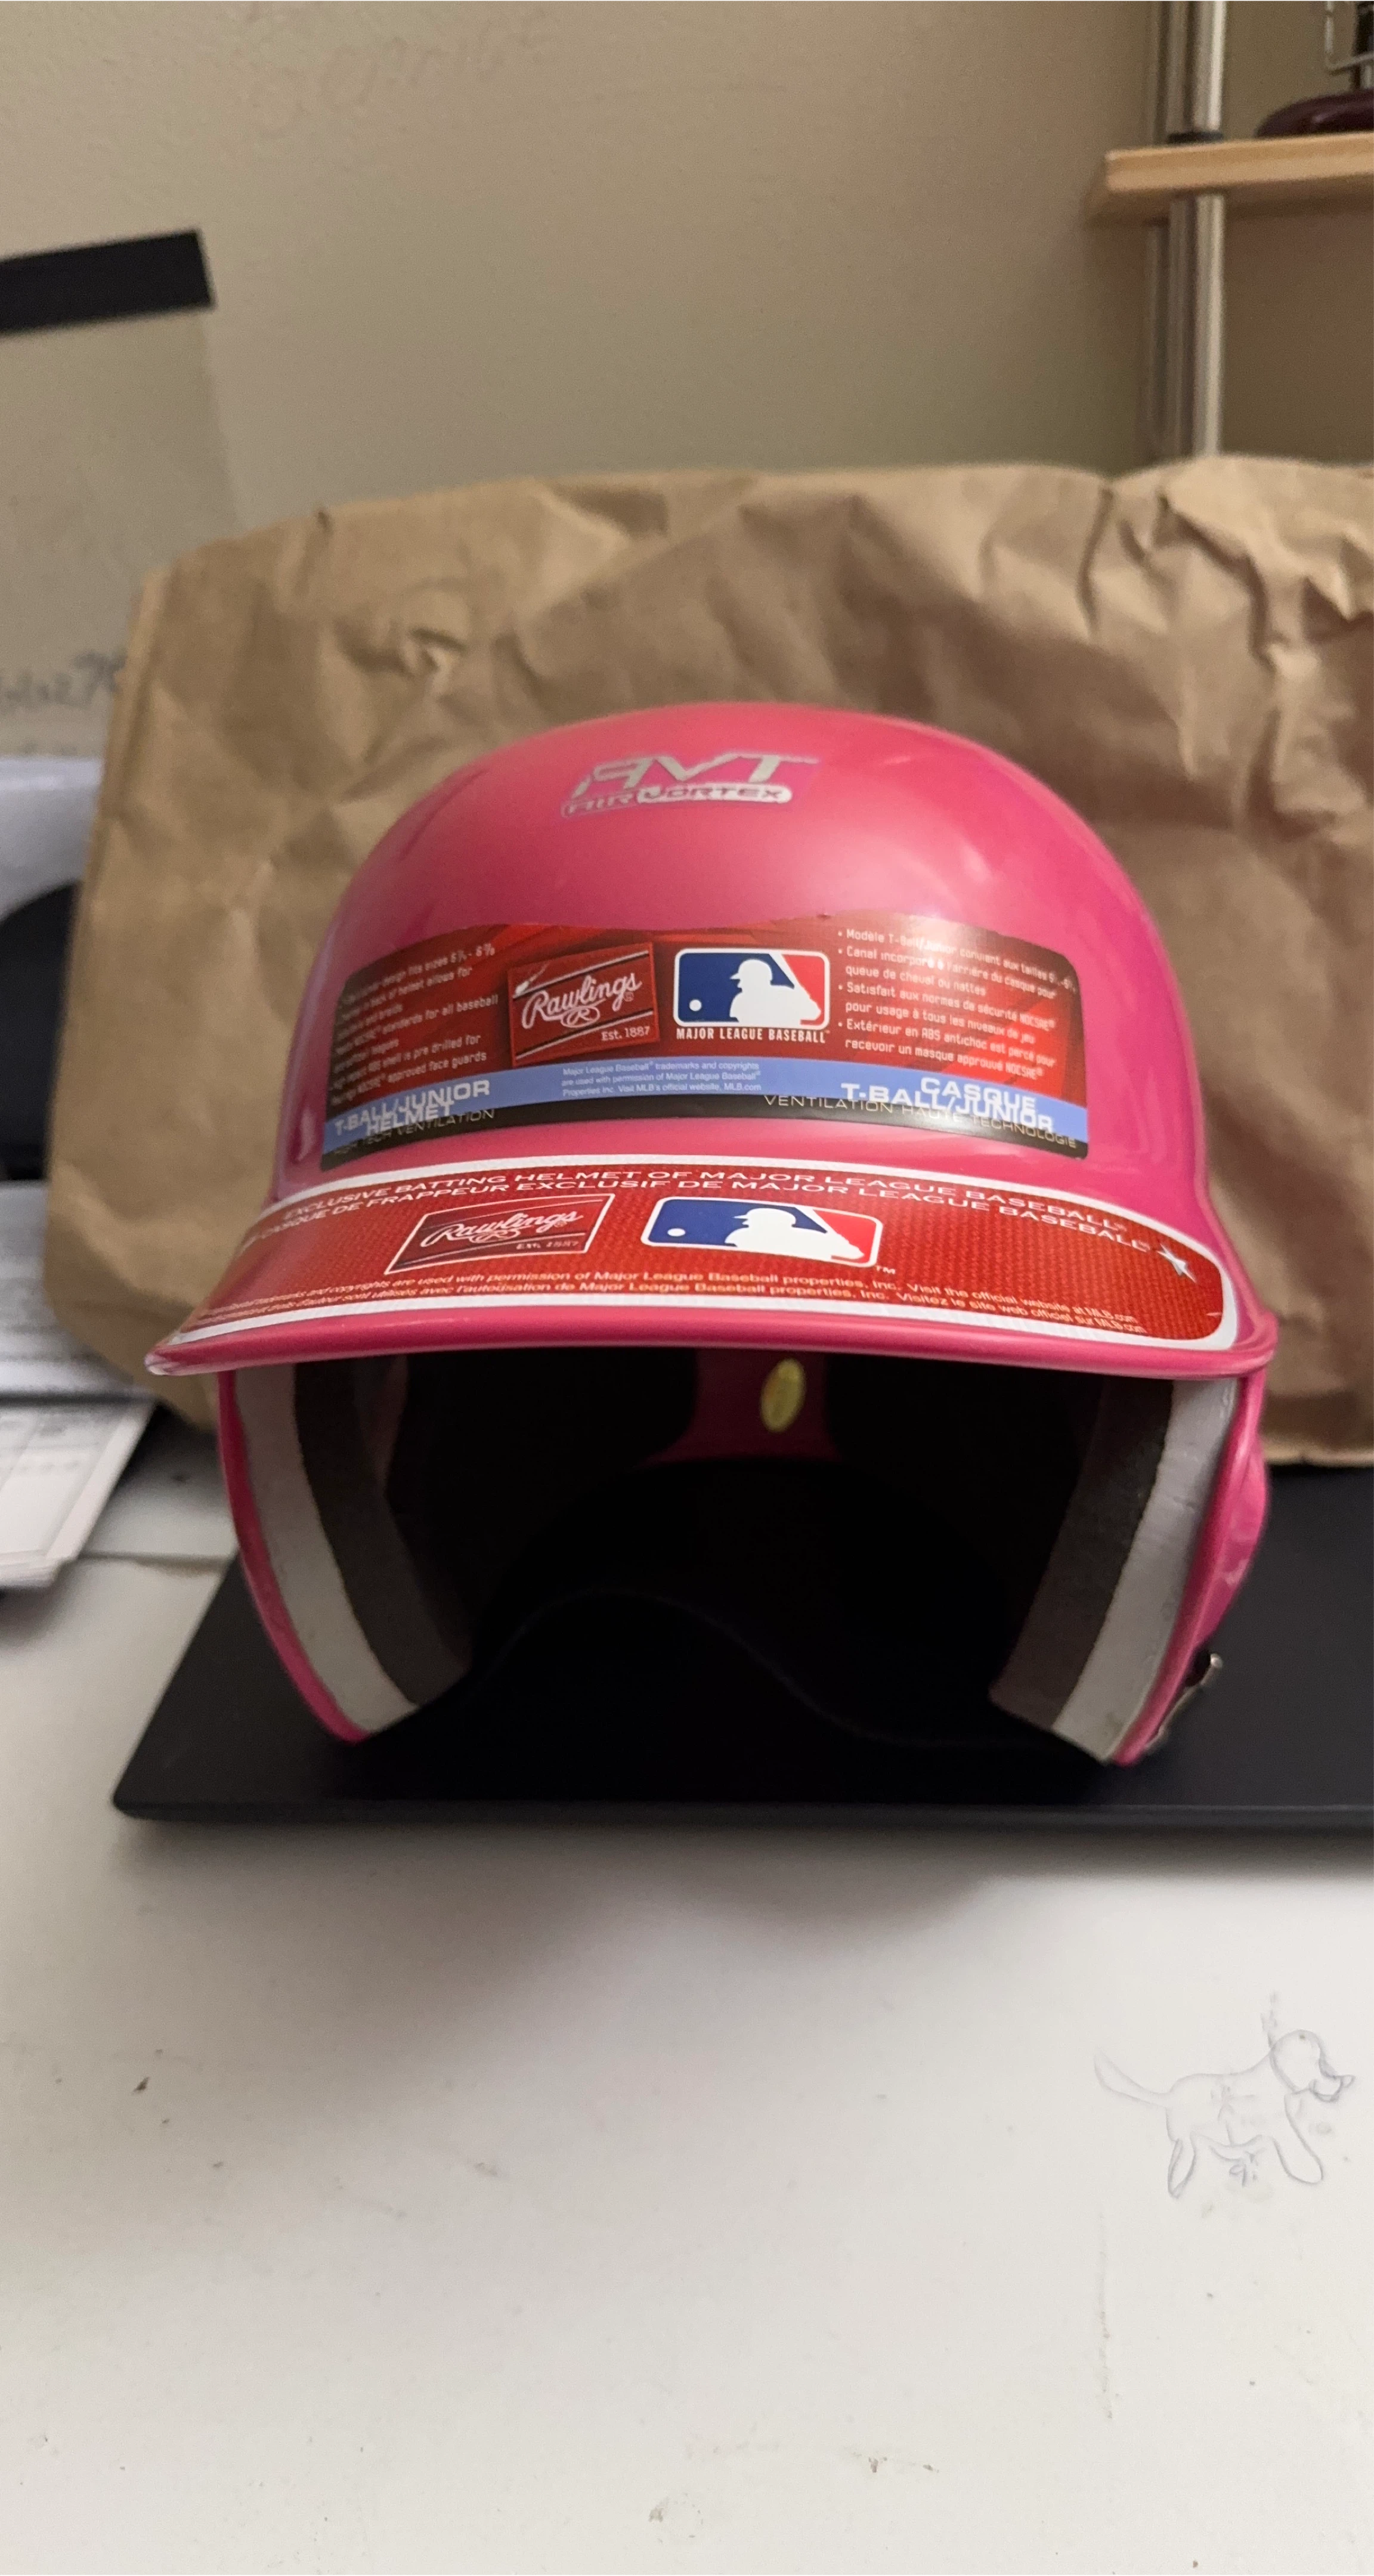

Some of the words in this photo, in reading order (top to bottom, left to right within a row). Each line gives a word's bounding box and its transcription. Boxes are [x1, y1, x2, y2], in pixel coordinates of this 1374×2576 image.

[571, 751, 820, 800] AVT
[642, 786, 784, 800] VORTEX
[846, 928, 885, 943] Modèle
[846, 945, 877, 959] Canal
[845, 965, 880, 978] queue
[883, 968, 896, 980] de
[899, 970, 934, 986] cheval
[456, 993, 499, 1013] baseball
[521, 973, 643, 1030] Rawlings
[846, 981, 896, 998] Satisfait
[899, 989, 920, 1001] aux
[921, 992, 961, 1009] normes
[963, 999, 975, 1011] de
[845, 1001, 872, 1013] pour
[875, 1005, 910, 1020] usage
[912, 1008, 920, 1020] à
[923, 1010, 946, 1024] tous
[949, 1014, 965, 1027] les
[967, 1019, 1005, 1036] niveaux
[1007, 1026, 1019, 1040] de
[465, 1034, 482, 1046] for
[601, 1030, 623, 1042] Est.
[626, 1026, 651, 1038] 1887
[676, 1027, 714, 1041] MAJOR
[719, 1027, 763, 1041] LEAGUE
[846, 1017, 902, 1036] Extérieur
[905, 1027, 919, 1038] en
[921, 1027, 941, 1042] ABS
[944, 1032, 988, 1050] antichoc
[989, 1042, 1006, 1054] est
[451, 1051, 487, 1070] guards
[655, 1061, 700, 1070] trademarks
[701, 1061, 717, 1070] and
[718, 1061, 760, 1072] copyrights
[844, 1039, 895, 1053] recevoir
[898, 1044, 912, 1055] un
[915, 1046, 954, 1062] masque
[957, 1054, 1004, 1072] approuvé
[612, 1073, 655, 1084] permission
[655, 1073, 664, 1081] of
[665, 1072, 688, 1082] Major
[689, 1073, 720, 1082] League
[723, 1082, 762, 1091] MLB.com
[920, 1076, 1036, 1110] CASQUE
[366, 1100, 454, 1137] HELMET
[840, 1082, 1054, 1134] T-BALL/JUNIOR
[763, 1095, 893, 1114] VENTILATION
[972, 1114, 1077, 1148] TECHNOLOGIE
[395, 1175, 507, 1193] BATTING
[514, 1171, 642, 1182] HELMET
[647, 1171, 692, 1180] OF
[699, 1171, 815, 1183] MAJOR
[824, 1176, 957, 1197] LEAGUE
[331, 1202, 364, 1215] DE
[365, 1184, 510, 1208] FRAPPEUR
[515, 1180, 671, 1191] EXCLUSIF
[677, 1181, 724, 1189] DE
[731, 1181, 849, 1194] MAJOR
[858, 1187, 991, 1212] LEAGUE
[419, 1210, 585, 1248] Rawlings
[485, 1271, 571, 1283] permission
[574, 1271, 592, 1281] of
[593, 1271, 640, 1281] Major
[642, 1271, 704, 1283] League
[708, 1272, 779, 1283] Baseball
[906, 1283, 942, 1295] Visit
[943, 1286, 969, 1298] the
[554, 1282, 575, 1292] de
[578, 1281, 625, 1292] Major
[629, 1282, 691, 1293] League
[694, 1282, 766, 1293] Baseball
